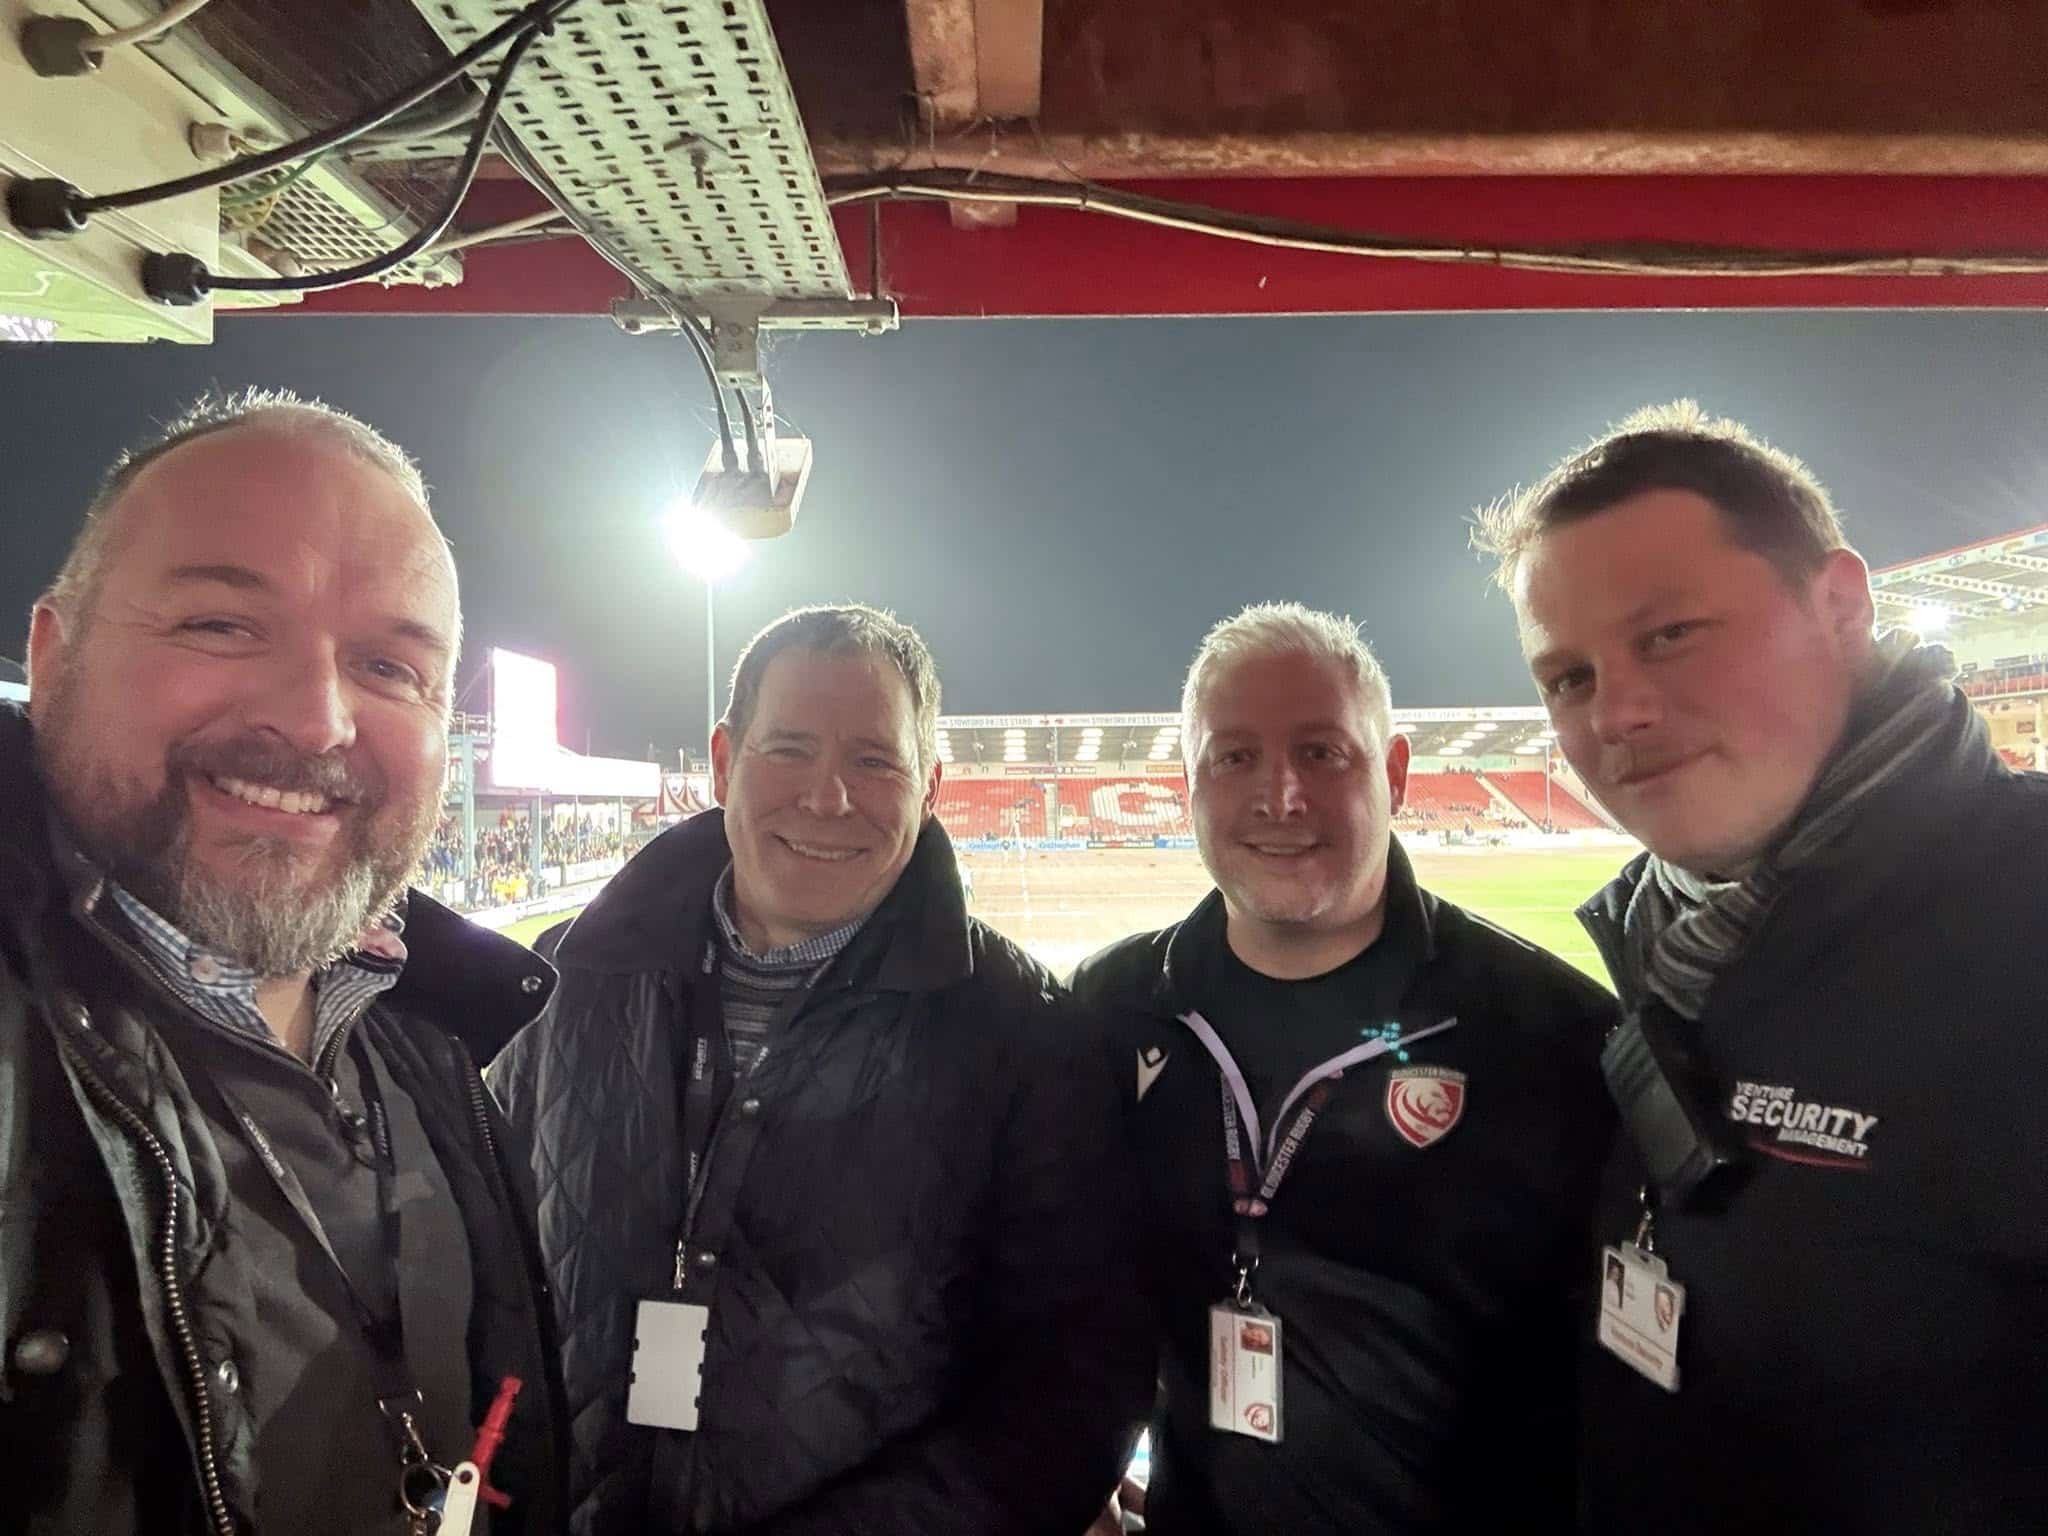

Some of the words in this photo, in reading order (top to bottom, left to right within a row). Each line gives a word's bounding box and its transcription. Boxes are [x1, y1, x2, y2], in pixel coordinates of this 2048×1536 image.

[1736, 1081, 1794, 1100] VENTURE
[1731, 1095, 1878, 1141] SECURITY
[1778, 1128, 1868, 1157] MANAGEMENT
